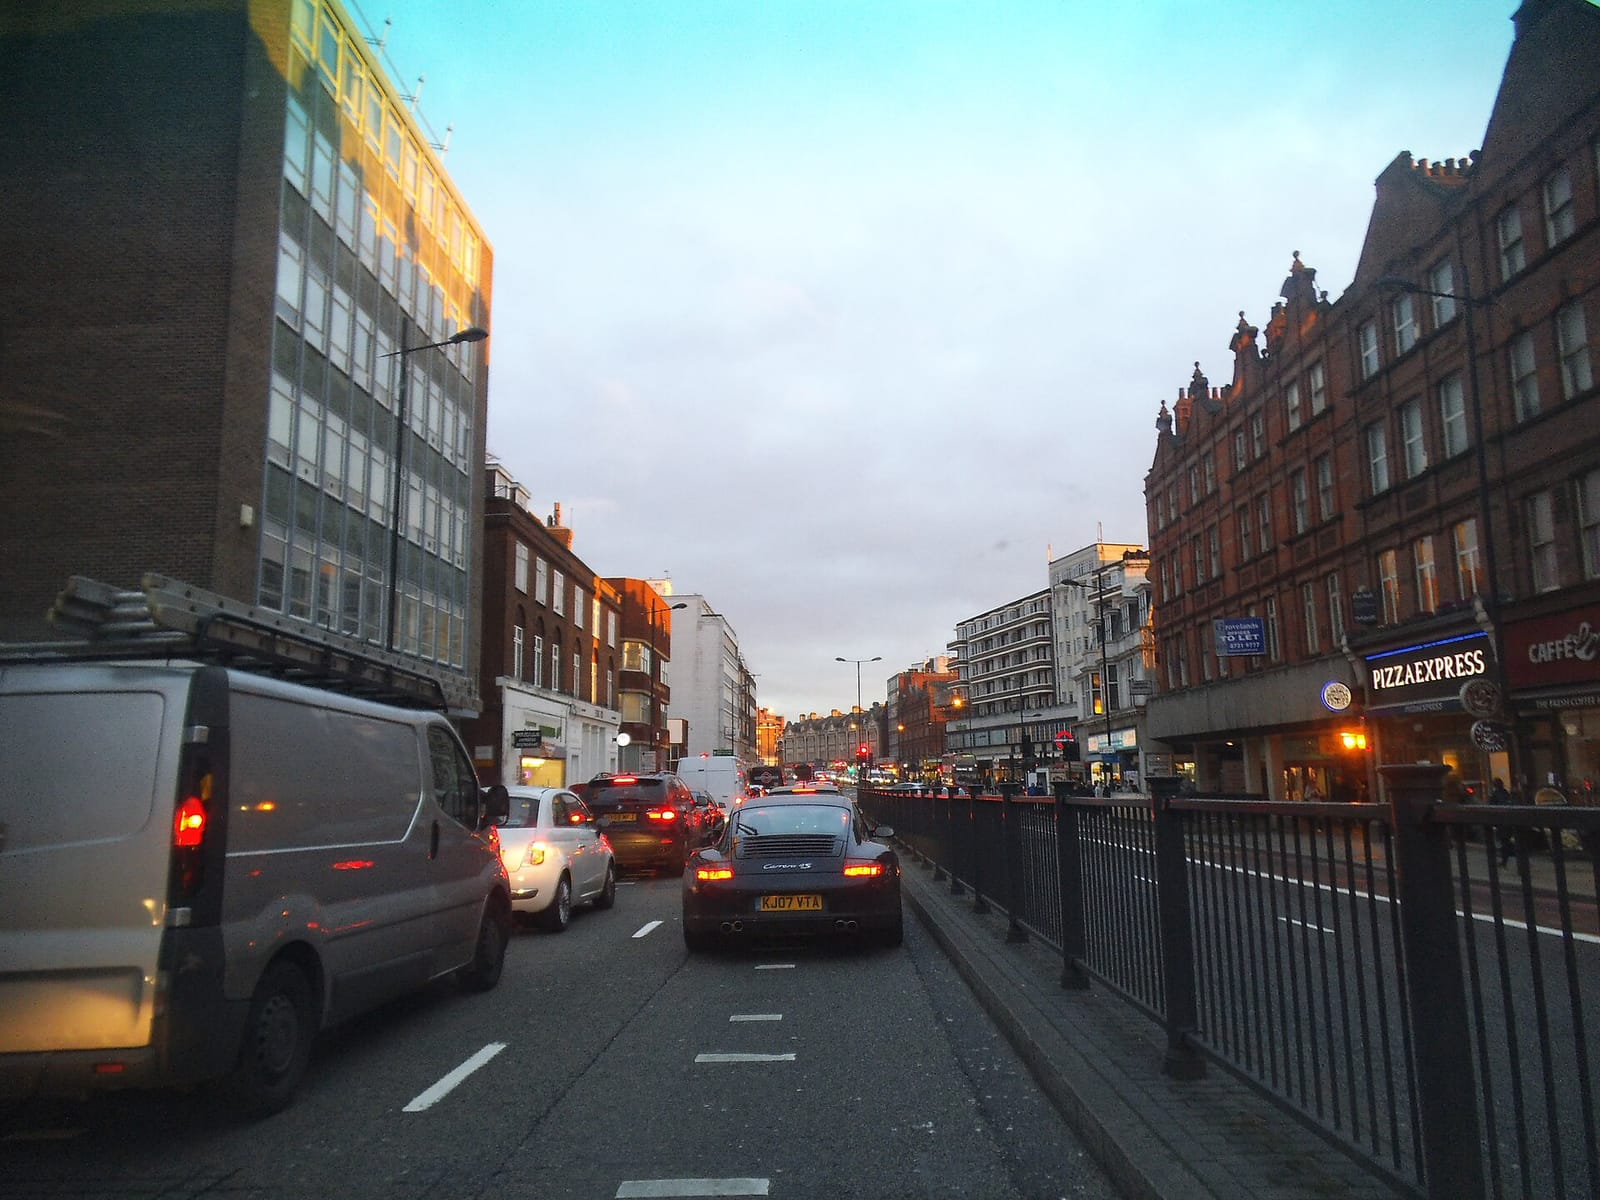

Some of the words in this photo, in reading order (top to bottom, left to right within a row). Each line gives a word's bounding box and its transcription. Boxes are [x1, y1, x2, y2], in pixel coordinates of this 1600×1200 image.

[1372, 649, 1485, 690] PIZZAEXPRESS
[762, 897, 793, 908] KJ07
[797, 896, 820, 908] VTA
